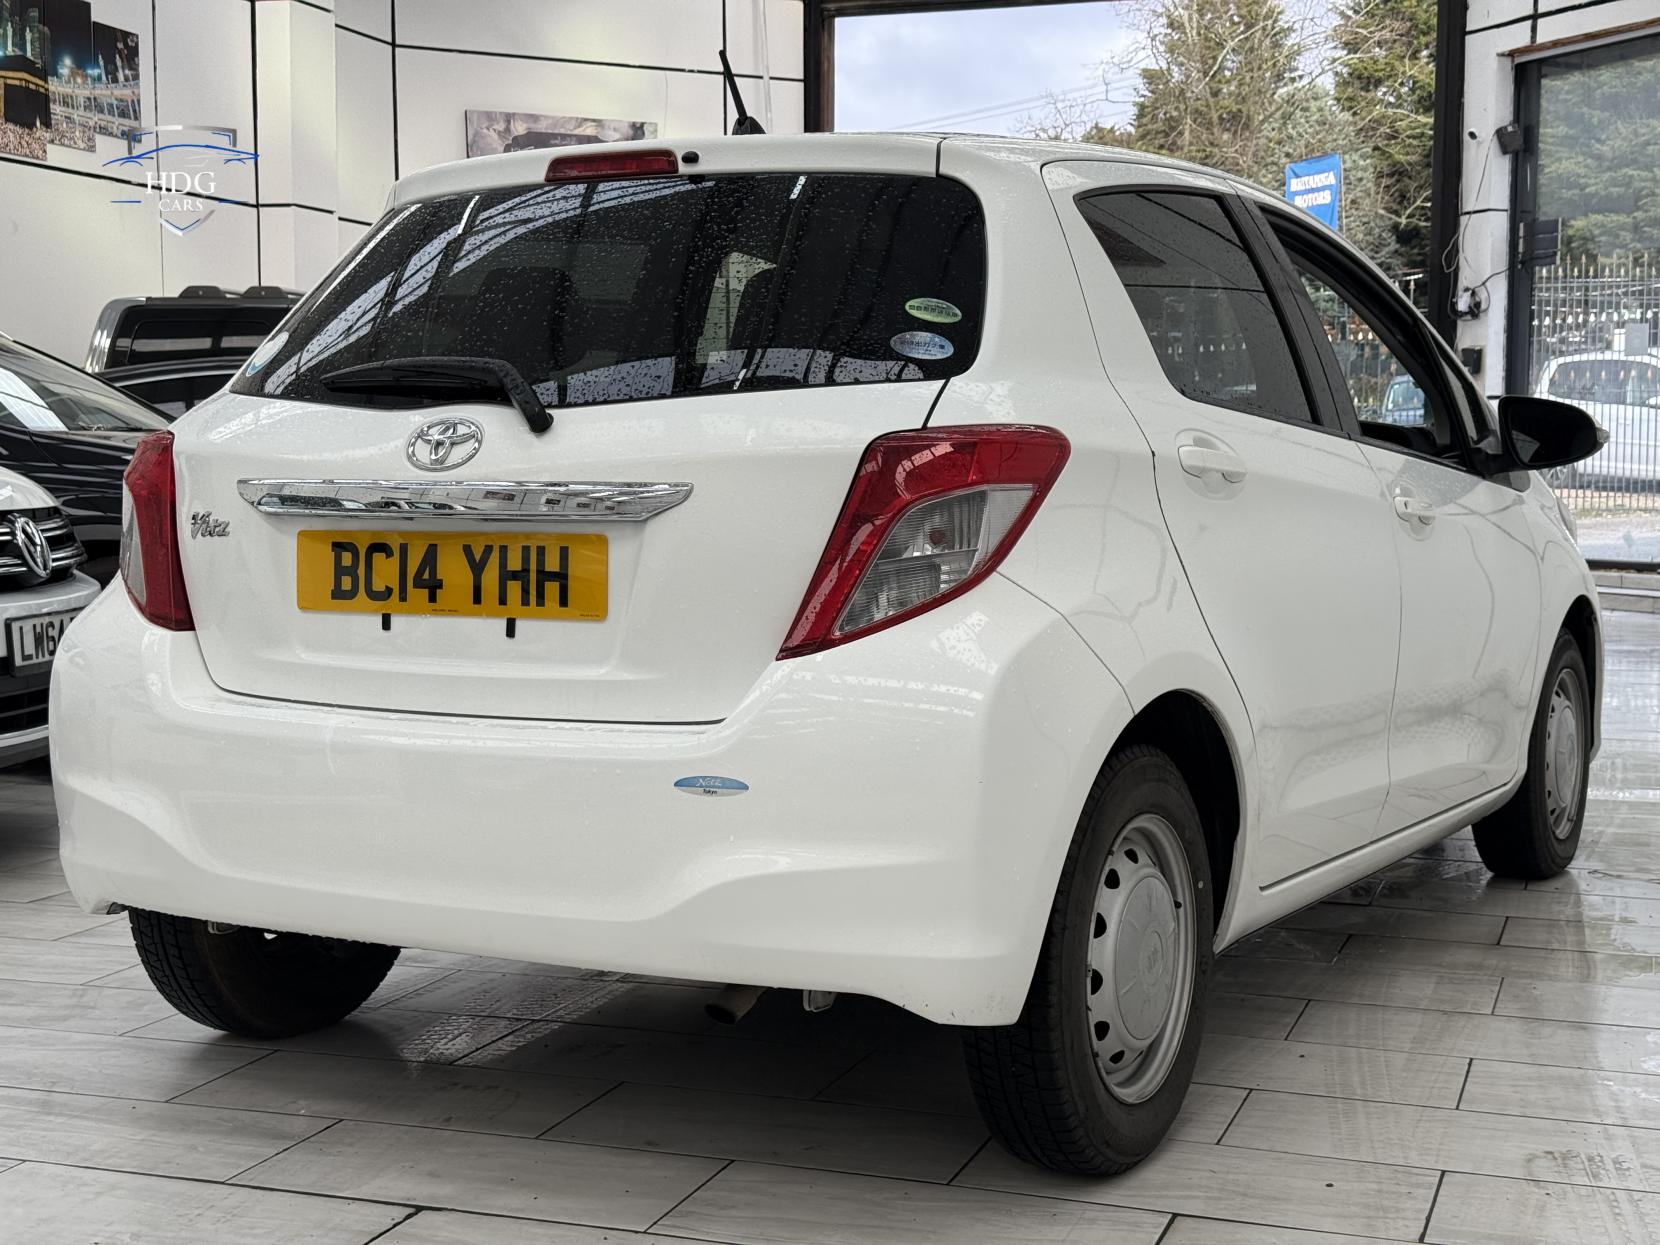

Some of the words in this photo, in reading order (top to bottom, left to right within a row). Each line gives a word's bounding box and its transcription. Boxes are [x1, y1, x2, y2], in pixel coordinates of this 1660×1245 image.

[191, 510, 231, 540] Vitz
[330, 541, 444, 604] BC14
[462, 543, 570, 608] YHH
